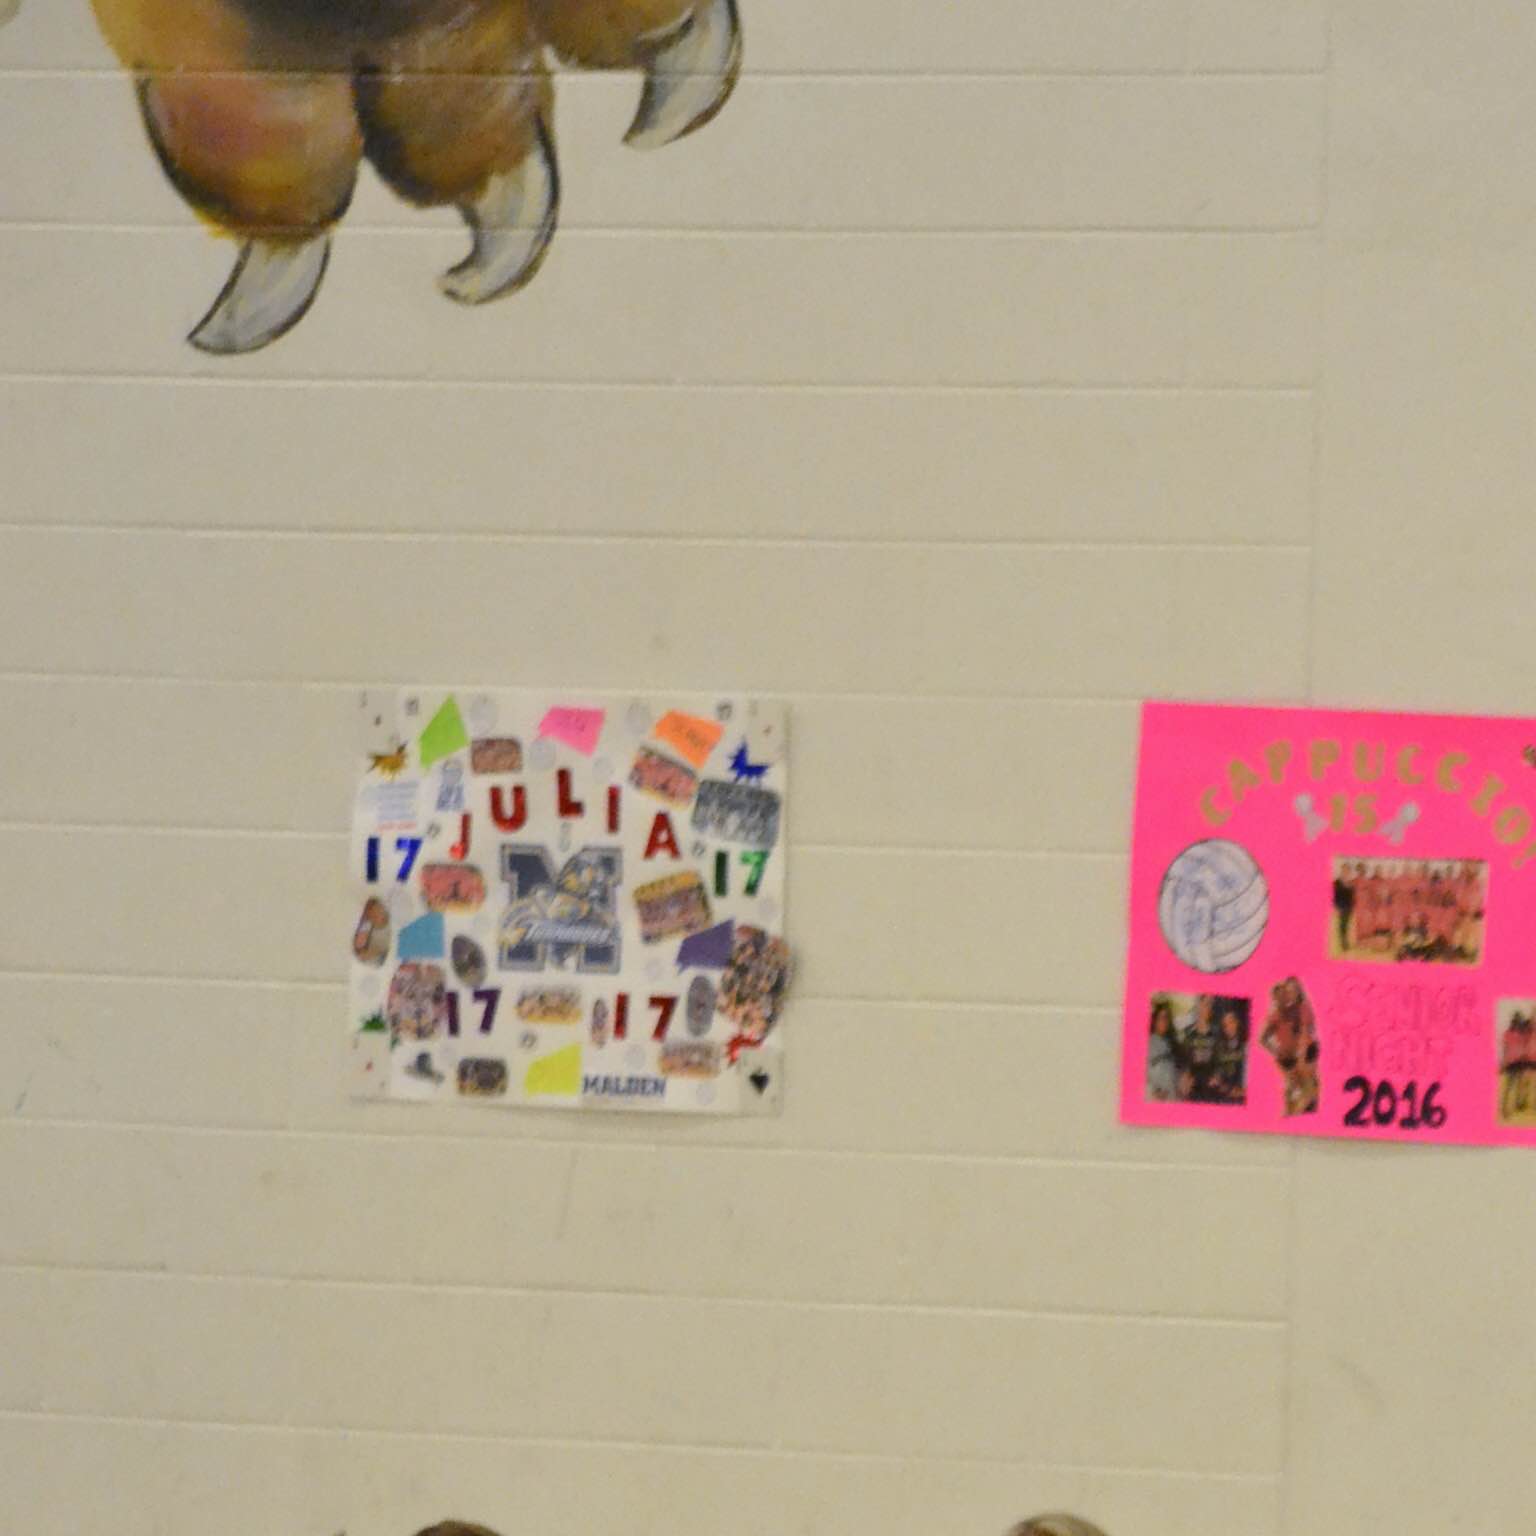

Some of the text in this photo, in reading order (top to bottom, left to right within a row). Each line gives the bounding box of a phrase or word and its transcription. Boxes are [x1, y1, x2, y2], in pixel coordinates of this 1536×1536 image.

[449, 767, 681, 861] JULIA
[365, 837, 423, 883] 17
[715, 850, 769, 898] 17
[447, 988, 502, 1037] 17
[613, 992, 679, 1041] 17
[1342, 1075, 1447, 1129] 2016
